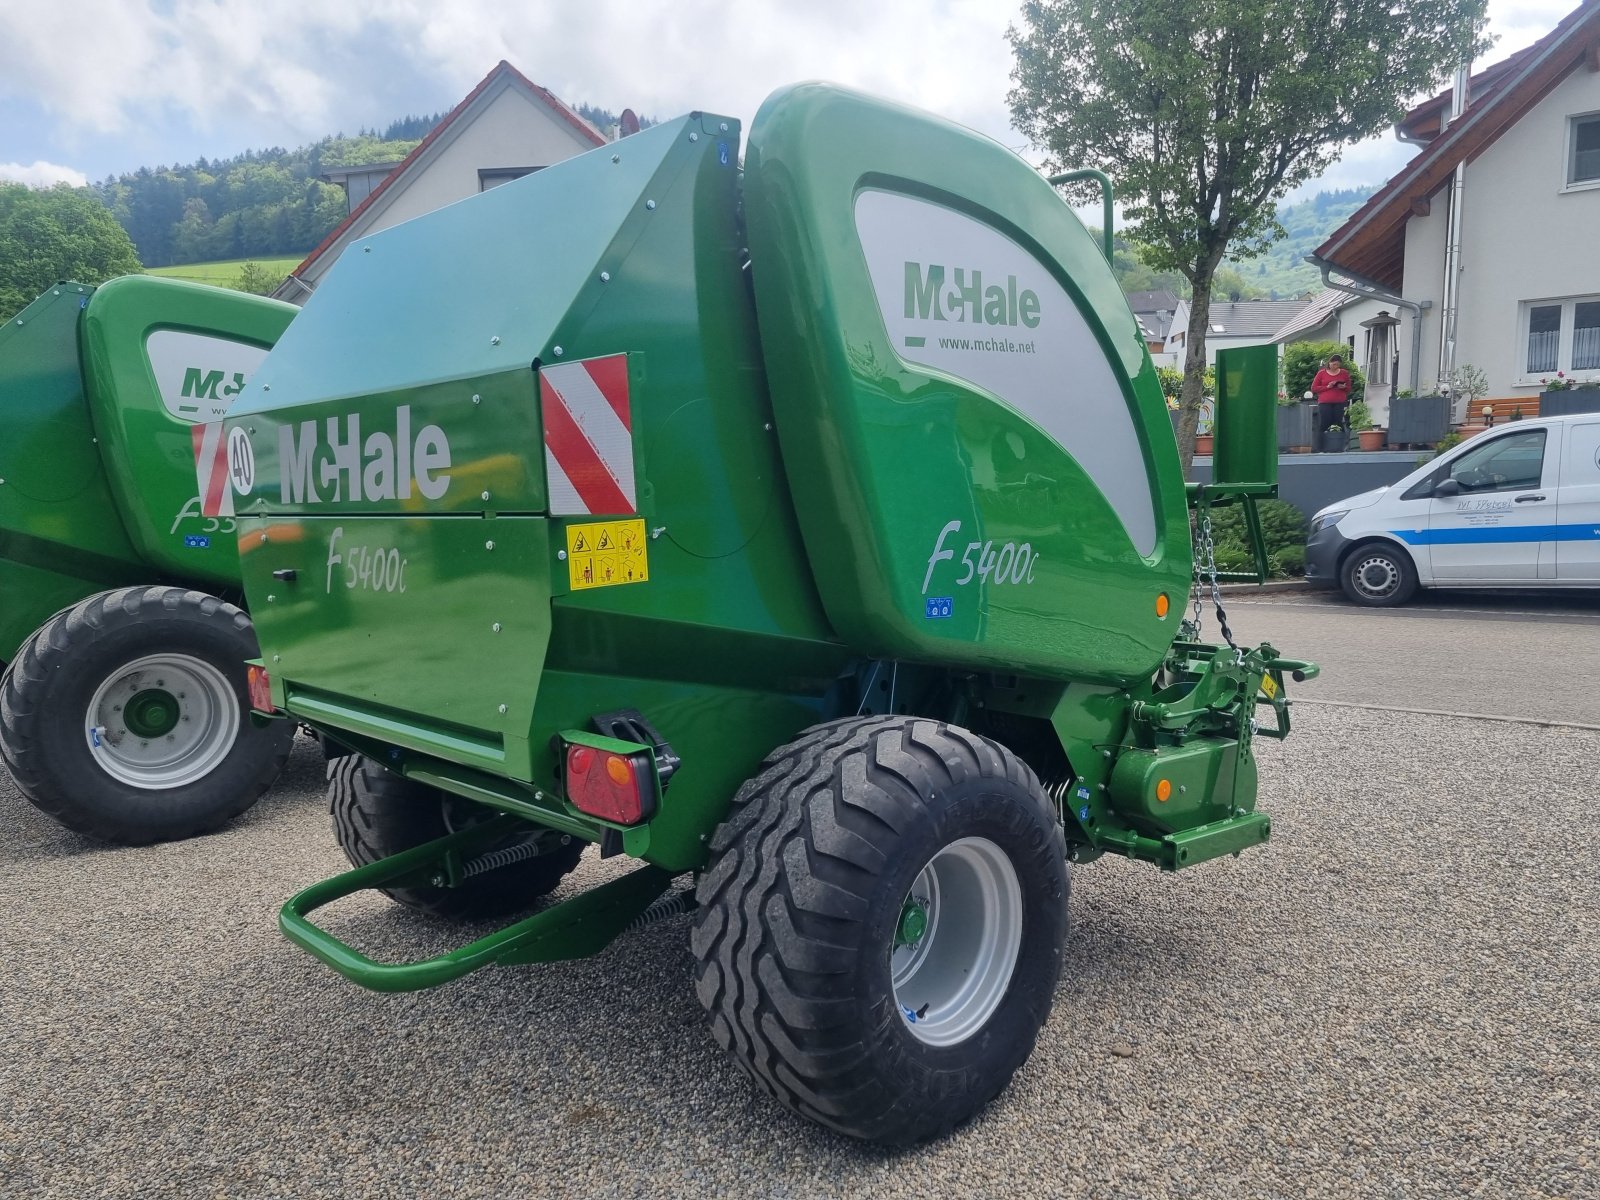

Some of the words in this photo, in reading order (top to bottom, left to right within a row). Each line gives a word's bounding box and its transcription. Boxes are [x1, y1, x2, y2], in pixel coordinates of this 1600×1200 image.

[903, 261, 1041, 329] McHale
[938, 336, 1036, 354] www.mchale.net
[233, 433, 251, 488] 40
[278, 404, 452, 504] McHale
